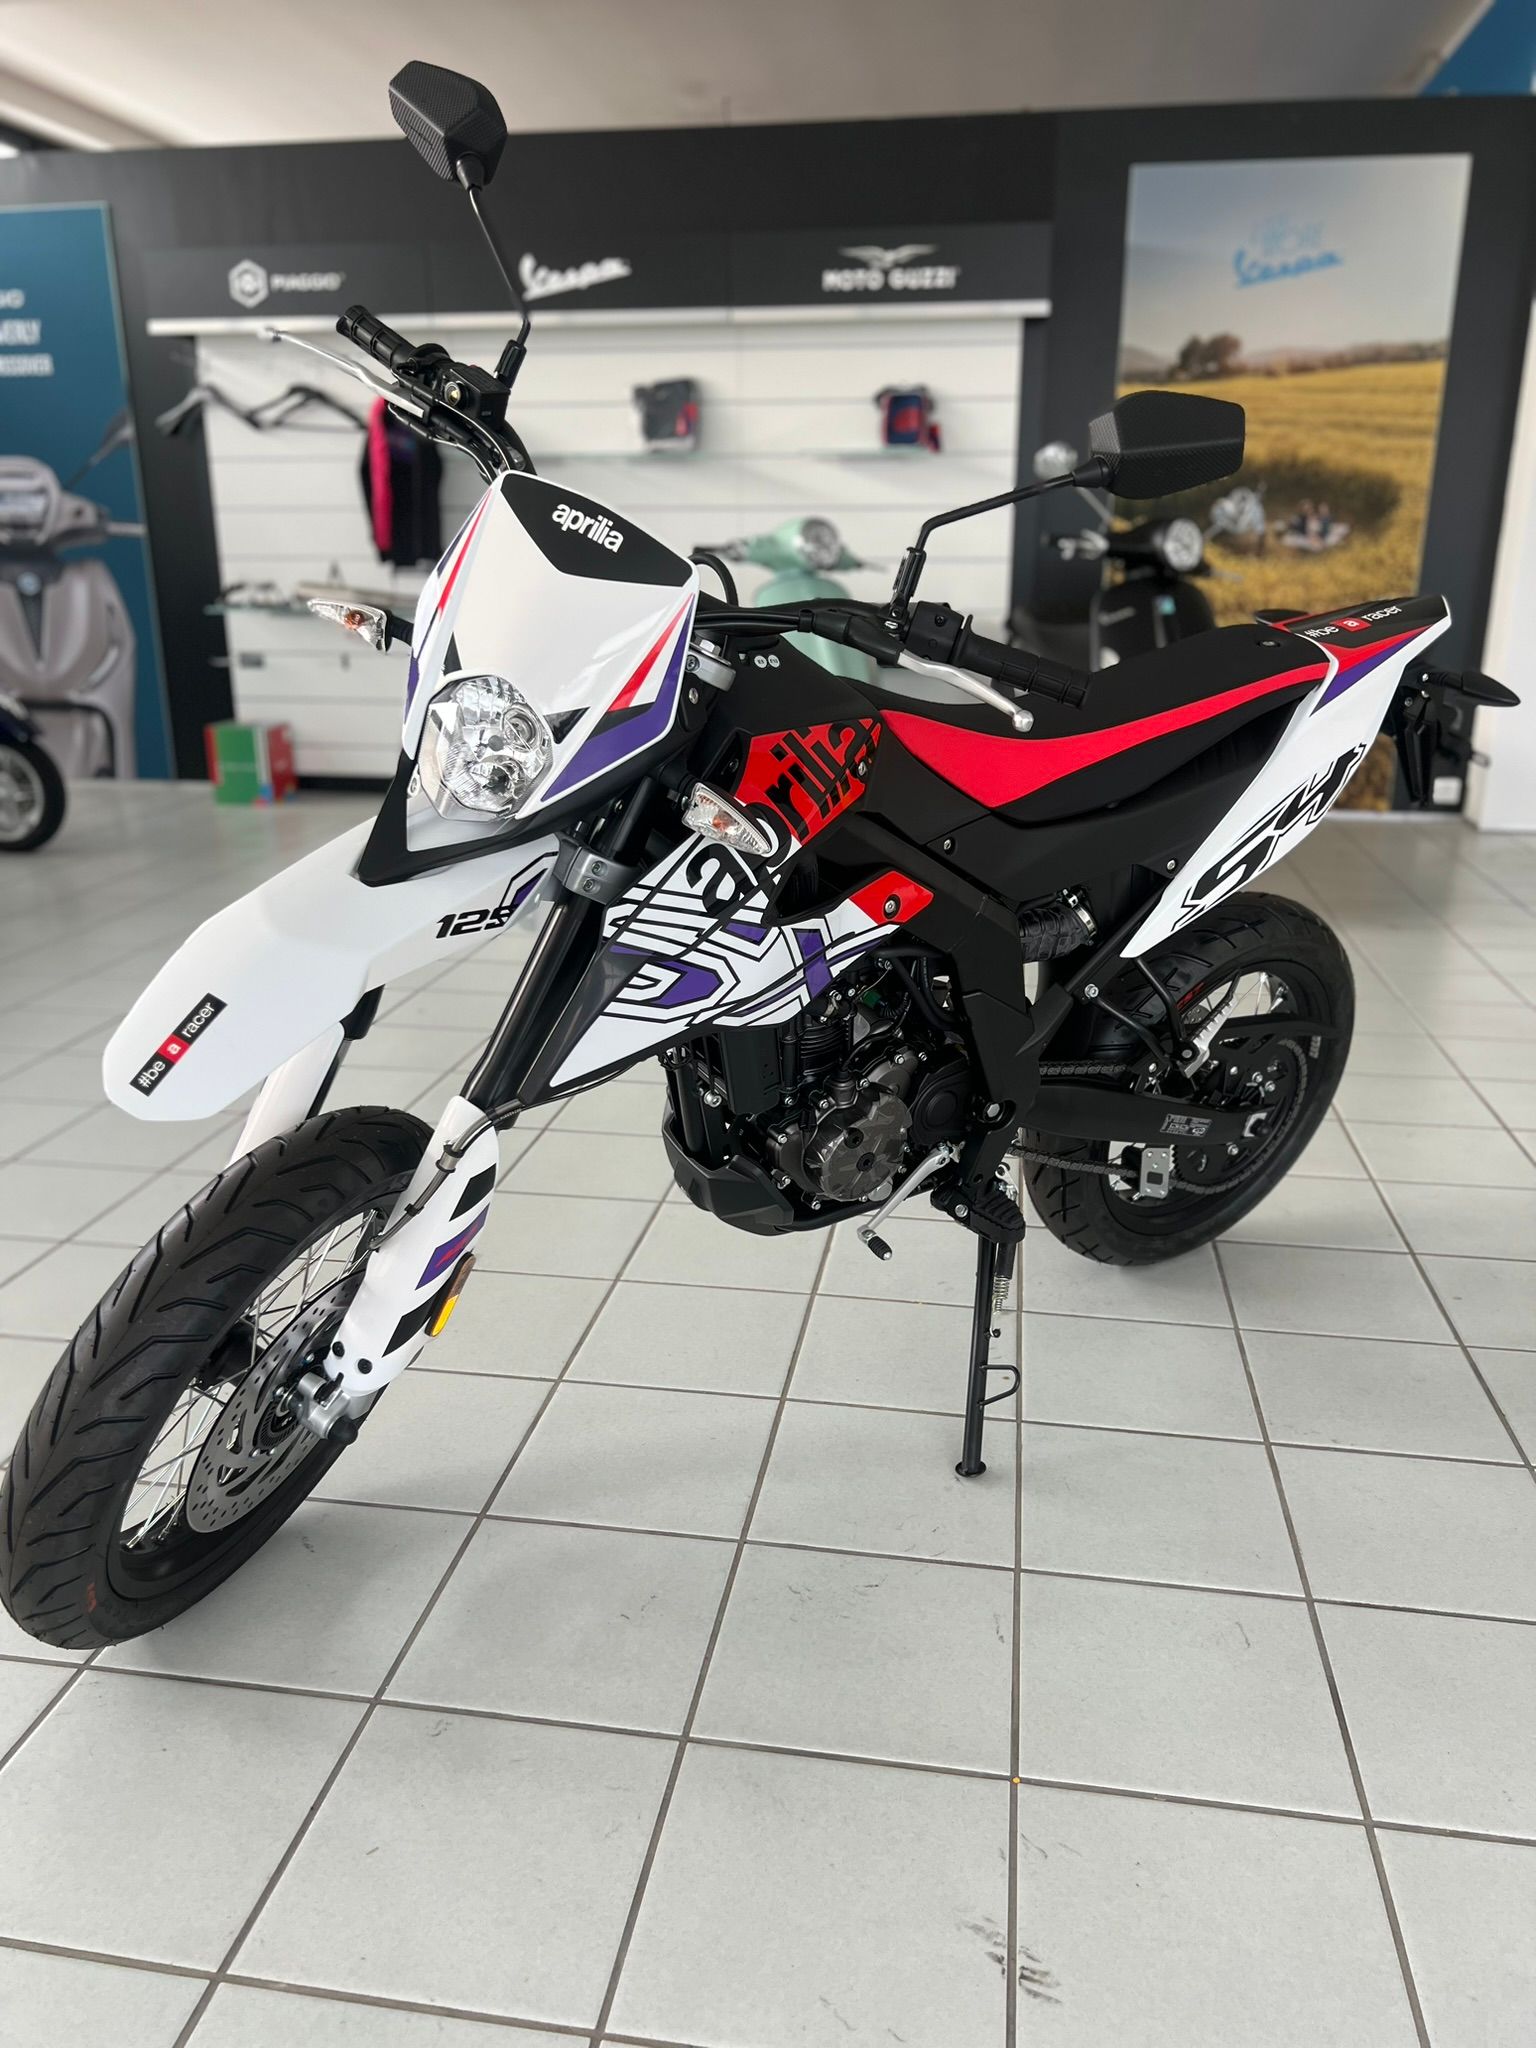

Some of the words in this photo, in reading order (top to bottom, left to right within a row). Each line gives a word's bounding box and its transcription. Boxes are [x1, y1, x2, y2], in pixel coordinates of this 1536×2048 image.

[519, 252, 631, 301] Vespa
[822, 268, 884, 291] MOTO
[887, 266, 956, 290] GUZZI
[552, 503, 624, 553] aprilia
[1303, 625, 1340, 638] #be
[1361, 605, 1402, 621] racer
[138, 1061, 166, 1088] #be
[181, 1002, 215, 1038] racer
